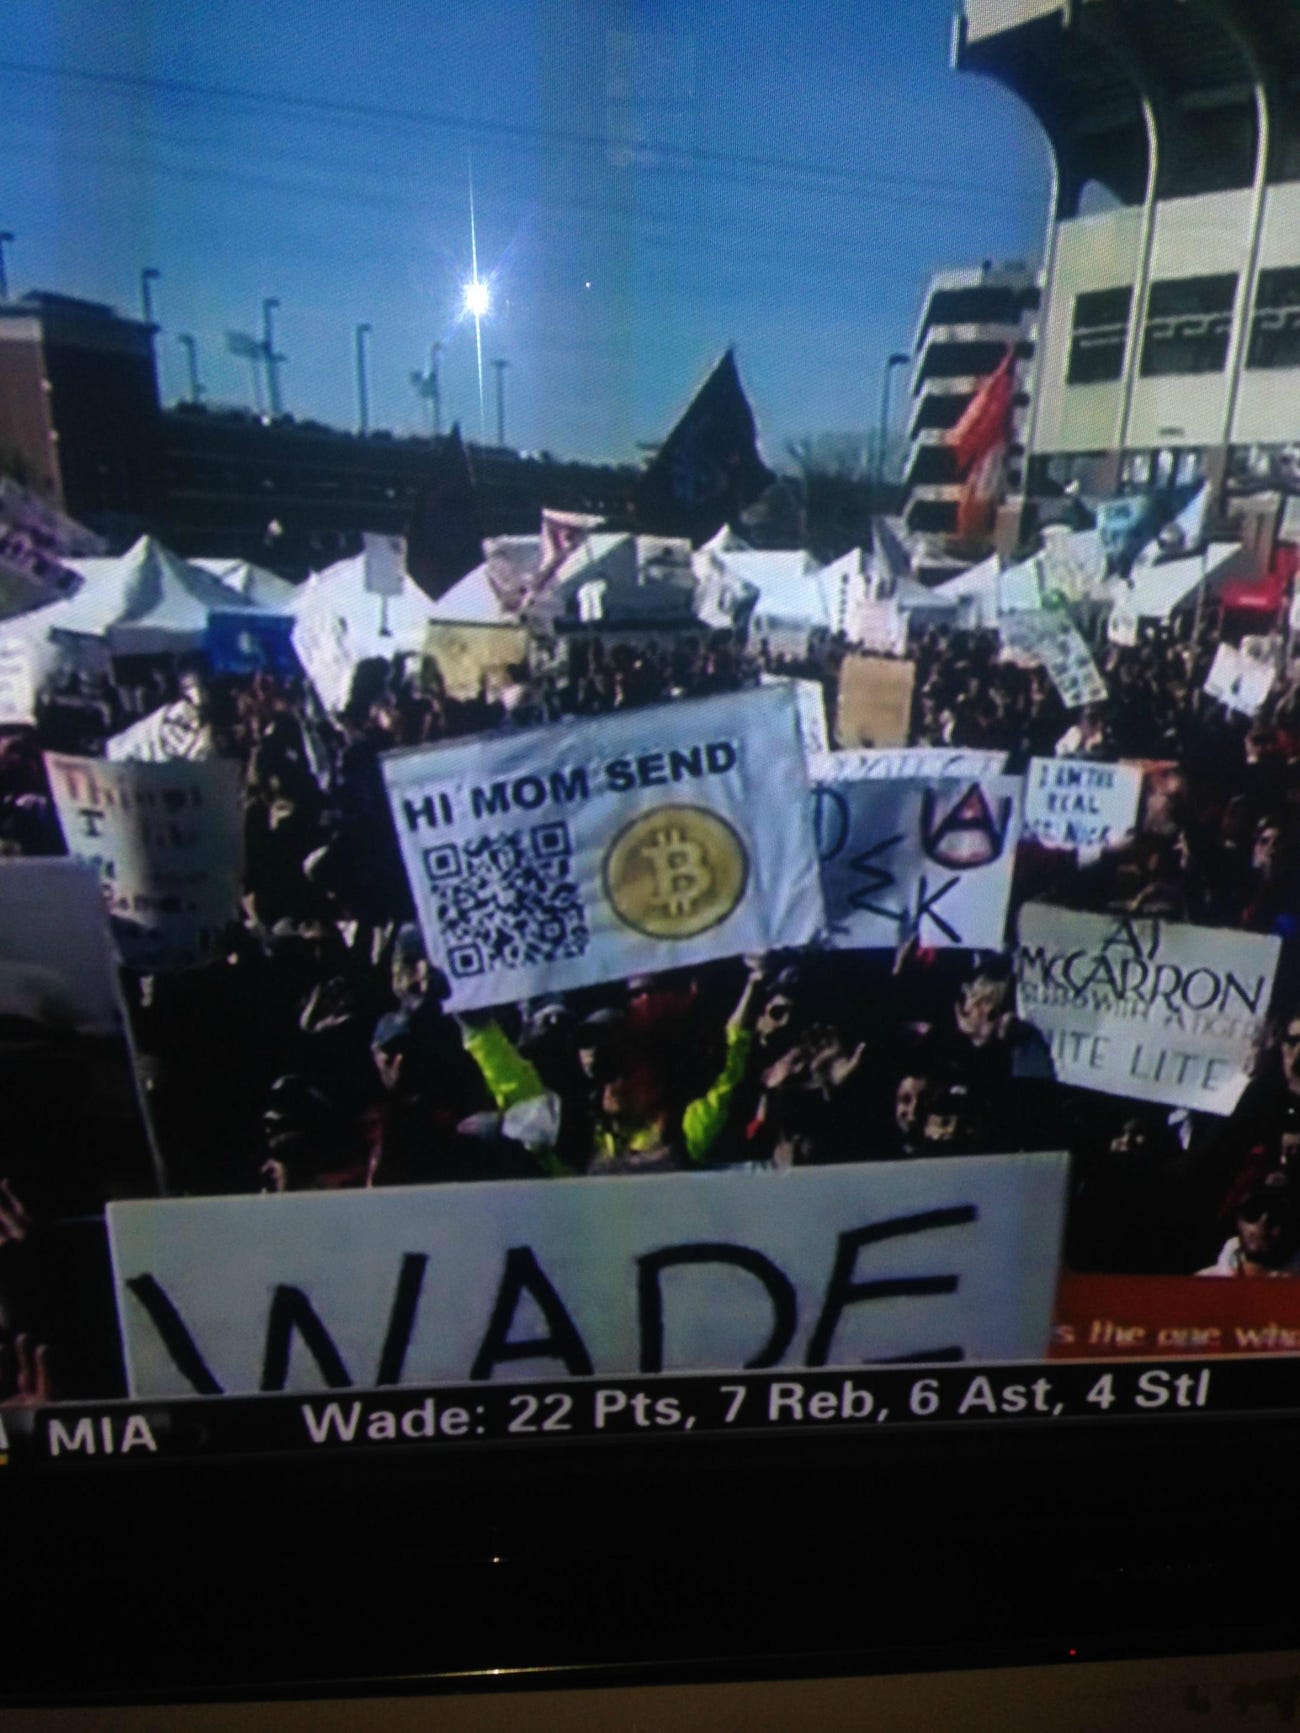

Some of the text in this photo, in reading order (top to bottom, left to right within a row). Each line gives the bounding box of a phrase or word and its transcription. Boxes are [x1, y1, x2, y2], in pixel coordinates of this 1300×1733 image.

[403, 741, 738, 831] HI MOM SEND
[1102, 918, 1160, 960] AJ
[1131, 1044, 1230, 1091] LITE
[126, 1204, 978, 1395] WADE
[49, 1415, 157, 1456] MIA
[302, 1369, 1210, 1443] Wade: 22 Pts, 7 Reb, 6 Ast, 4 Stl
